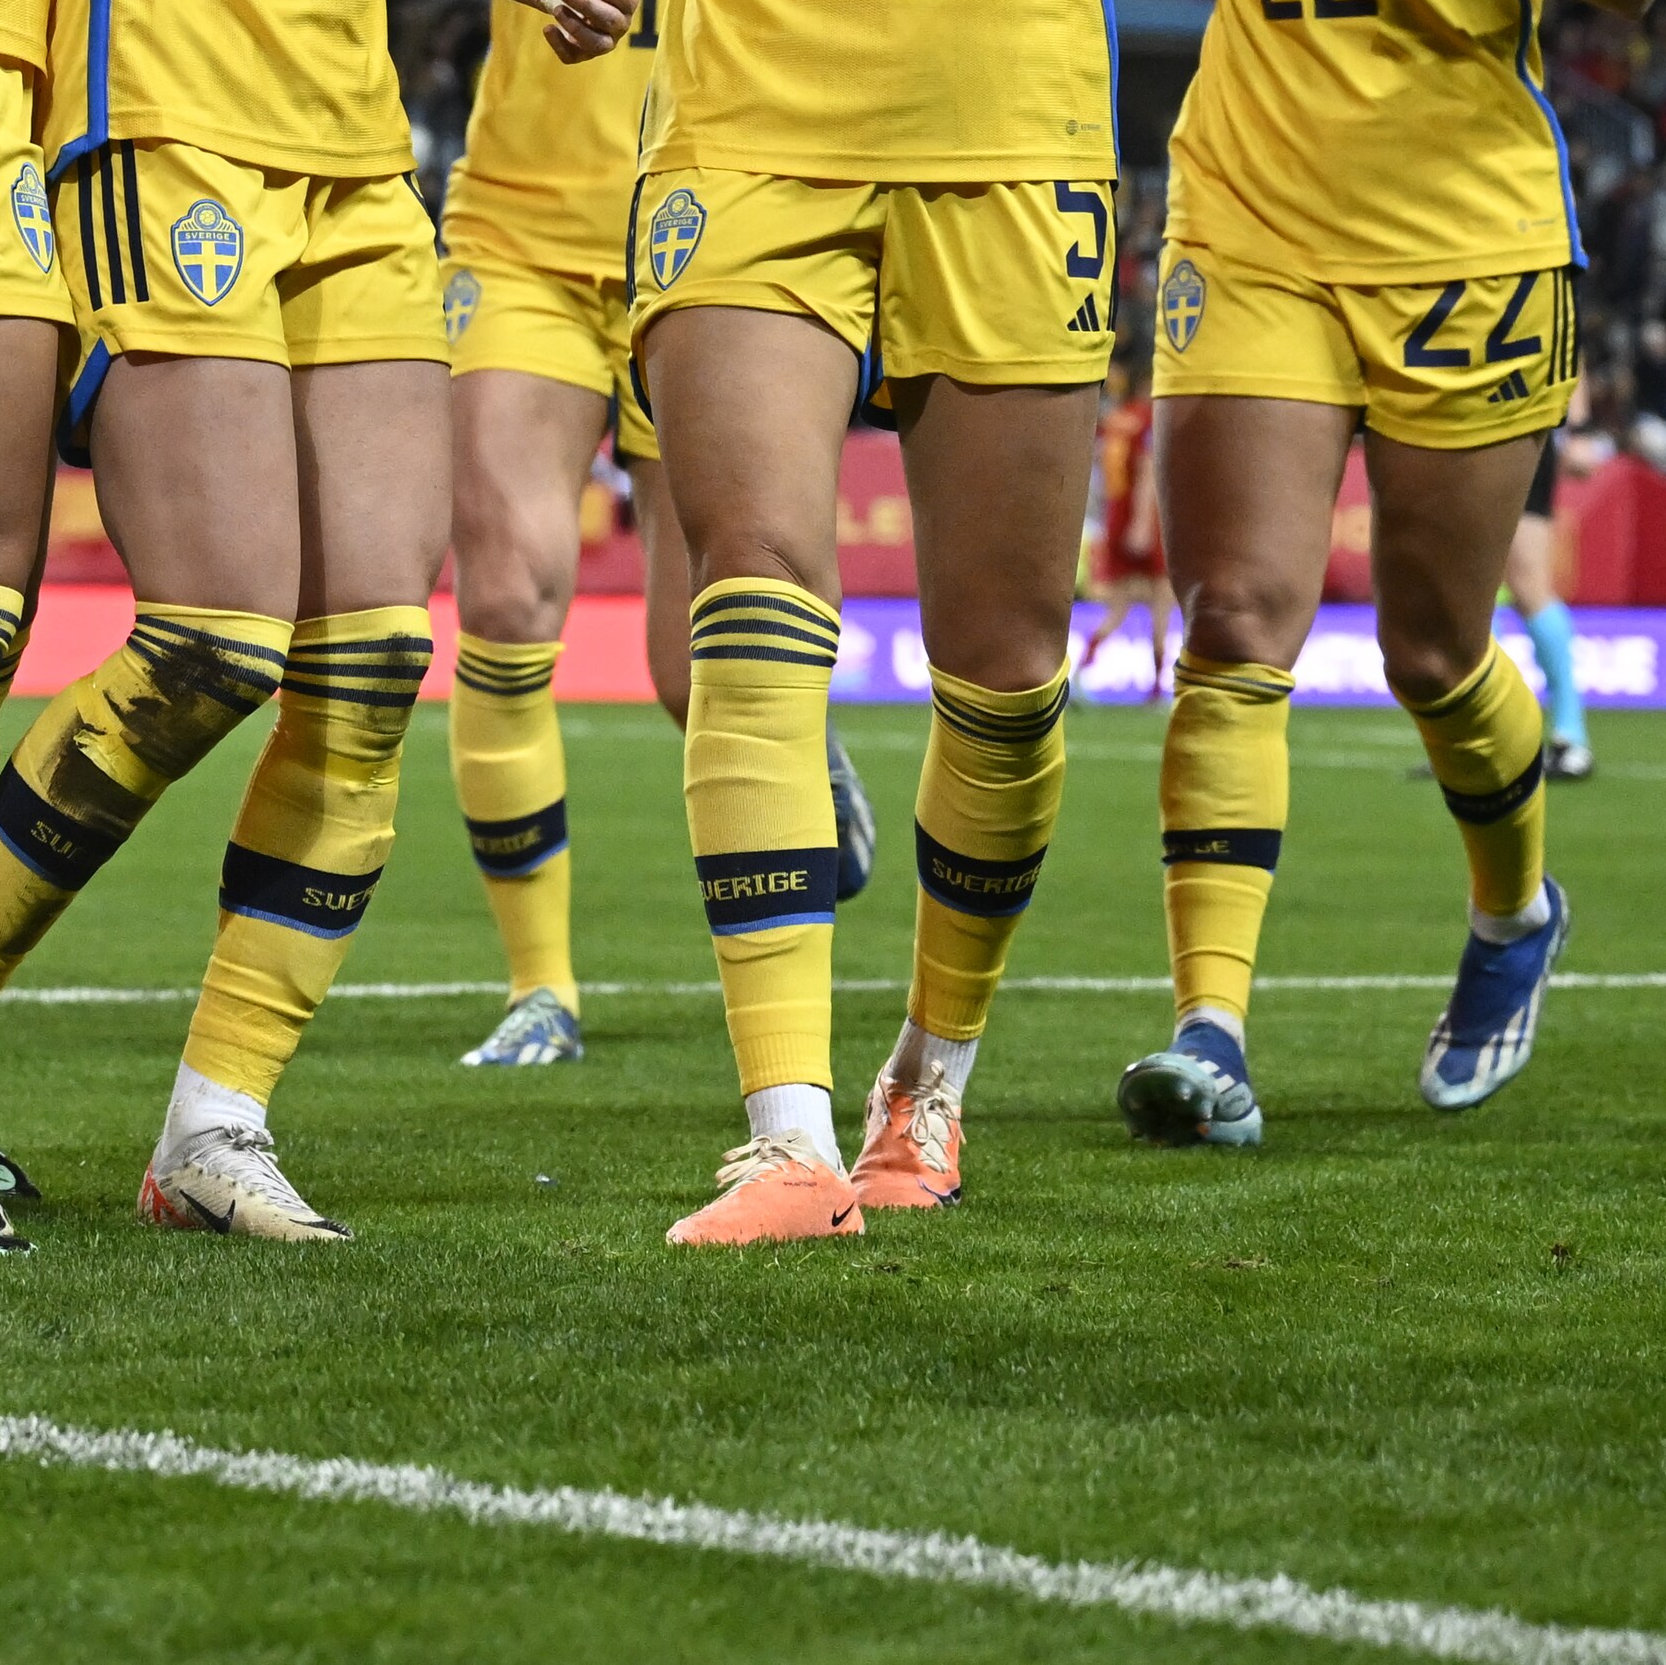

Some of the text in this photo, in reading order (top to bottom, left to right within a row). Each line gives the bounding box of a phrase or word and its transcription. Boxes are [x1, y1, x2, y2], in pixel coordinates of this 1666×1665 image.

[185, 232, 230, 241] SVERIGE
[1054, 181, 1108, 280] 5
[1404, 272, 1542, 368] 22
[698, 870, 808, 902] VERIGE
